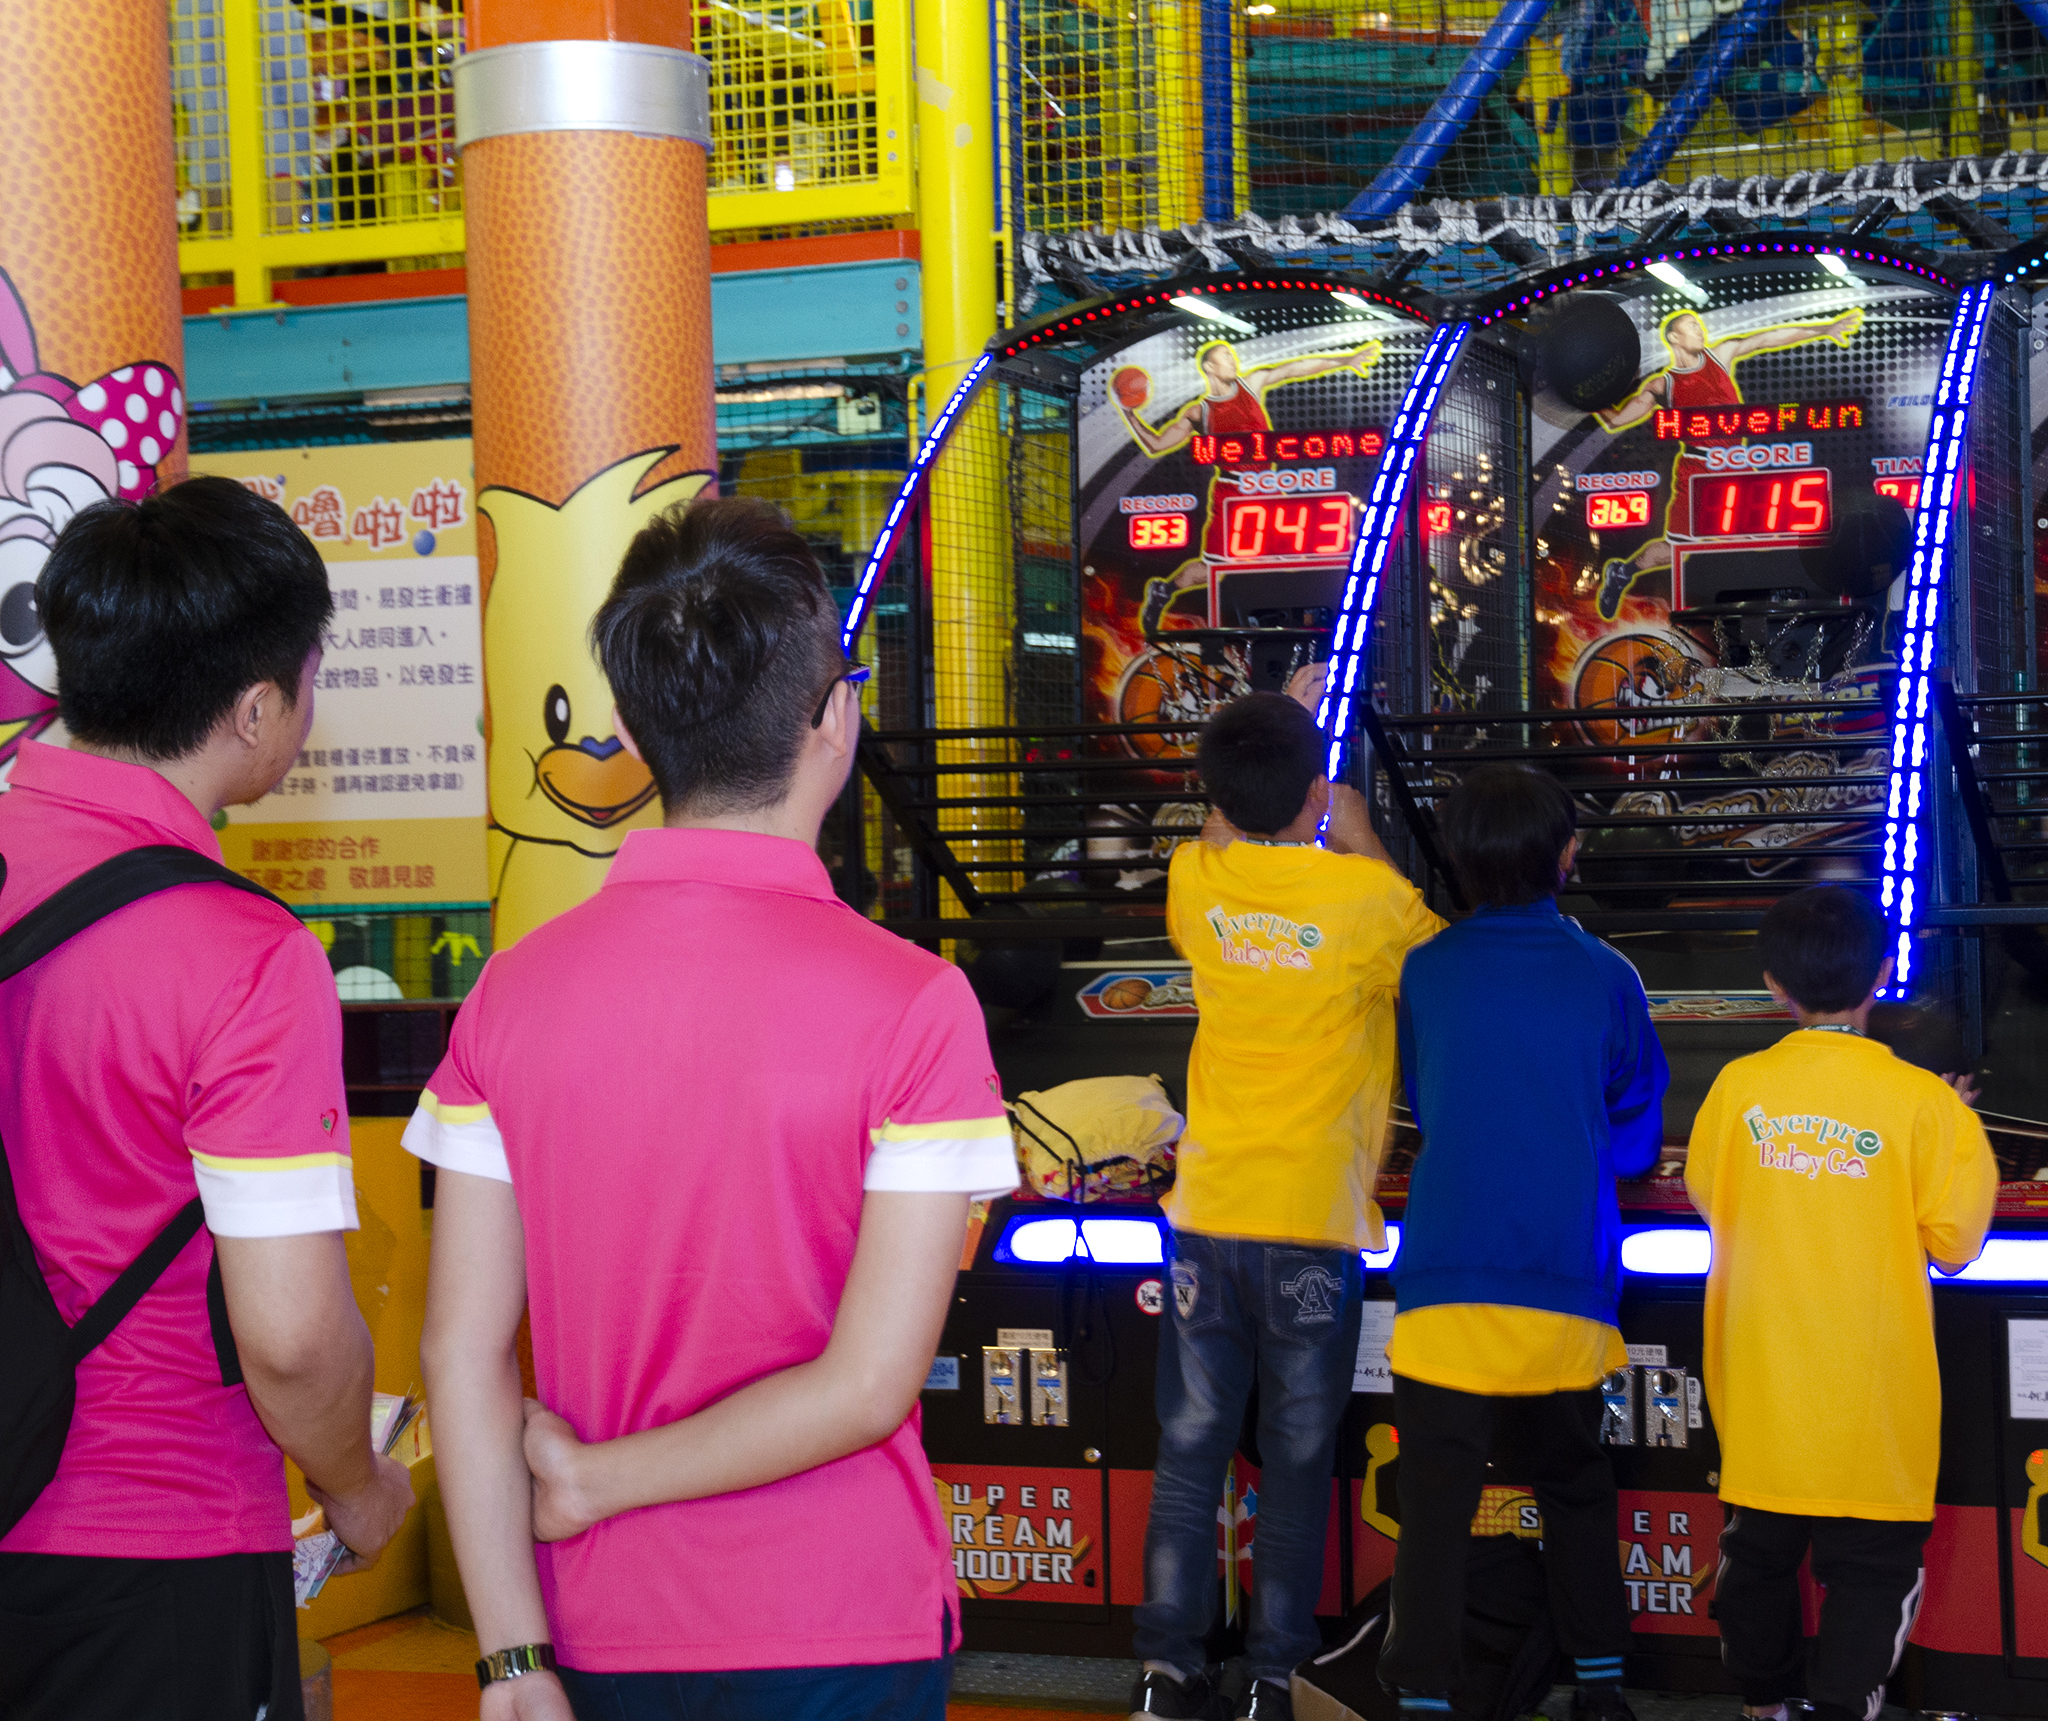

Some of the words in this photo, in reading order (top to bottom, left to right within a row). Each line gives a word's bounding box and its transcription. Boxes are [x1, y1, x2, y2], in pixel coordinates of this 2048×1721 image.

[1192, 433, 1383, 464] Welcome
[1707, 444, 1812, 468] SCORE
[1871, 458, 1924, 474] TIM
[1240, 469, 1336, 492] SCORE
[1577, 473, 1659, 491] RECORD
[1120, 495, 1197, 513] RECORD
[1591, 497, 1648, 526] 369
[1721, 477, 1825, 532] 115
[1132, 518, 1188, 545] 353
[1230, 501, 1350, 557] 043
[251, 836, 379, 861] 謝謝您的合作
[240, 867, 326, 891] 不便之處
[1221, 938, 1273, 971] Baby
[1760, 1141, 1824, 1179] Baby
[952, 1483, 1073, 1510] UPER
[952, 1513, 1074, 1549] REAM
[952, 1549, 1076, 1585] HOOTER
